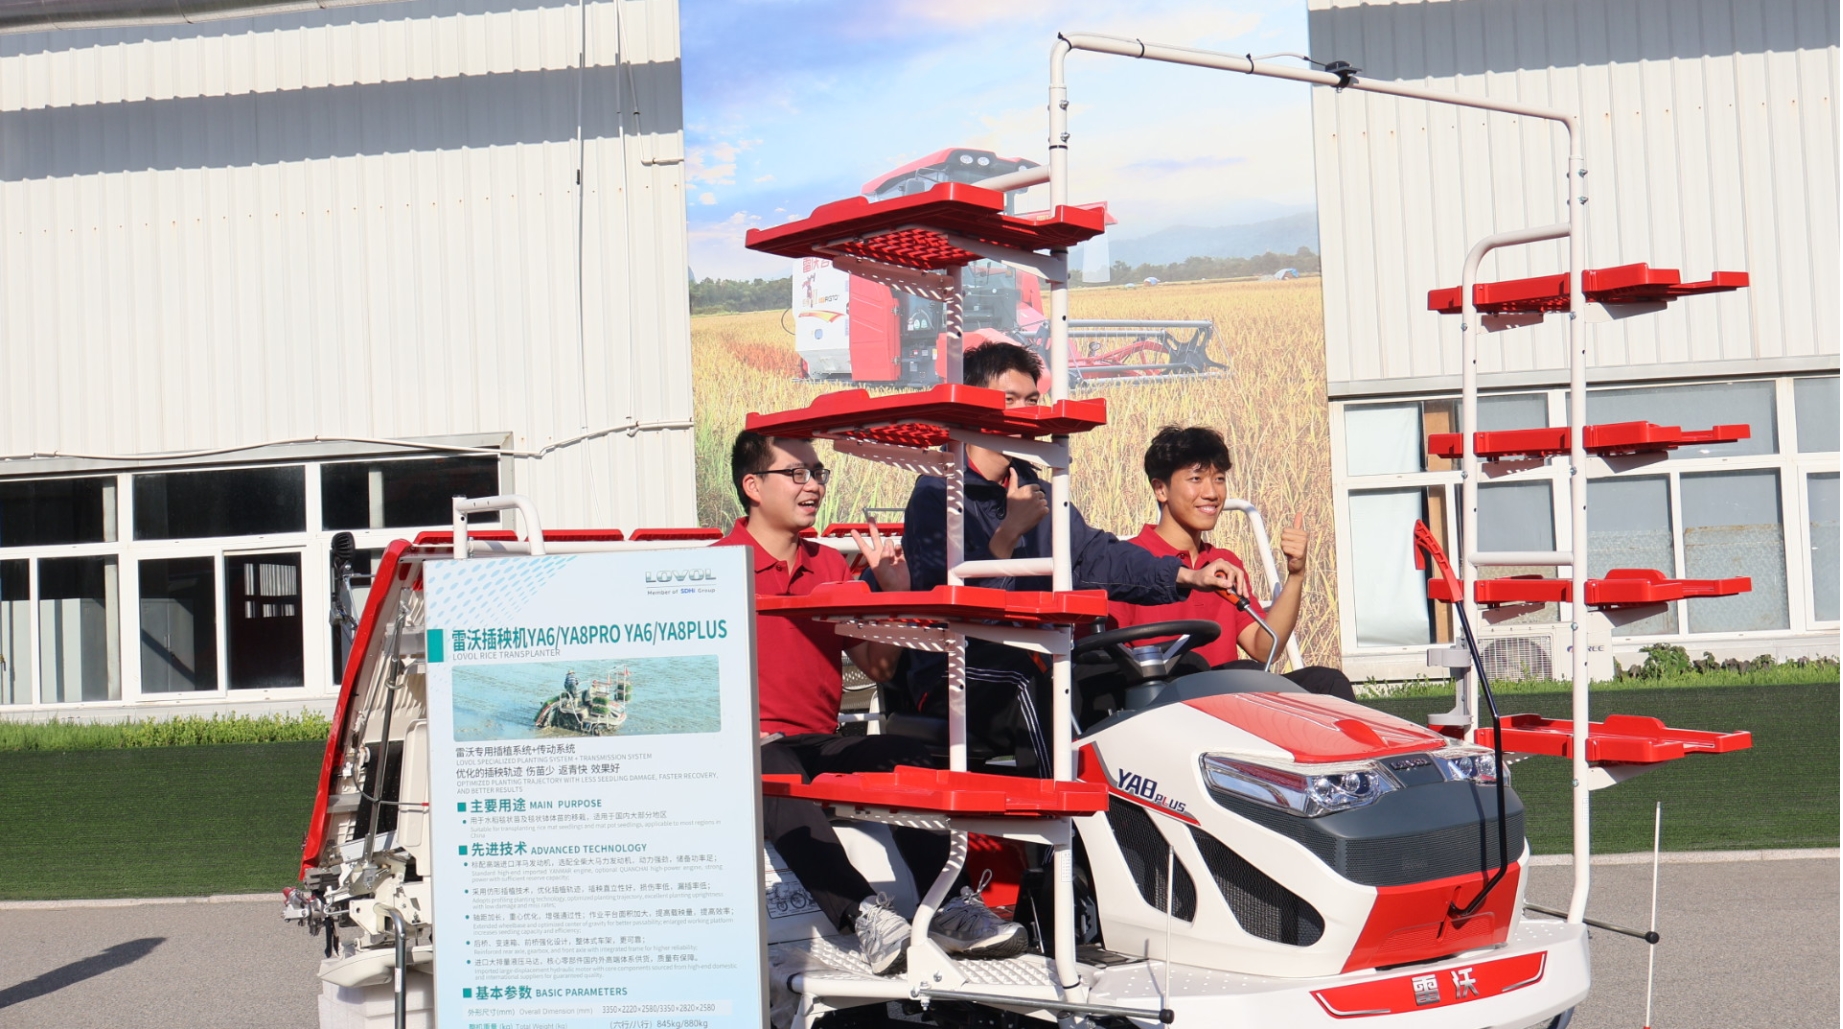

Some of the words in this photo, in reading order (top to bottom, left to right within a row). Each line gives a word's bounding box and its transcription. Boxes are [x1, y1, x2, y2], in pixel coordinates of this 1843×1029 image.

[645, 569, 716, 583] LOVOL
[624, 618, 727, 646] YA6/YA8PLUS
[499, 649, 560, 658] TRANSPLANTER
[456, 744, 575, 758] 雷沃专用插植系统+传动系统
[456, 766, 523, 779] 优化的插秧轨迹
[526, 765, 555, 776] 伤苗少
[559, 764, 588, 775] 返青快
[591, 763, 620, 774] 效果好
[684, 772, 718, 780] RECOVERY,
[1118, 768, 1158, 800] YA8
[1154, 794, 1186, 812] PLUS
[470, 798, 526, 814] 主要用途
[530, 801, 553, 809] MAIN
[558, 799, 602, 808] PURPOSE
[471, 841, 528, 857] 先进技术
[531, 845, 580, 855] ADVANCED
[584, 843, 647, 854] TECHNOLOGY
[476, 985, 532, 1000] 基本参数
[536, 989, 563, 997] BASIC
[565, 987, 628, 997] PARAMETERS
[1412, 968, 1479, 1006] 雷沃
[576, 1007, 593, 1015] (mm)
